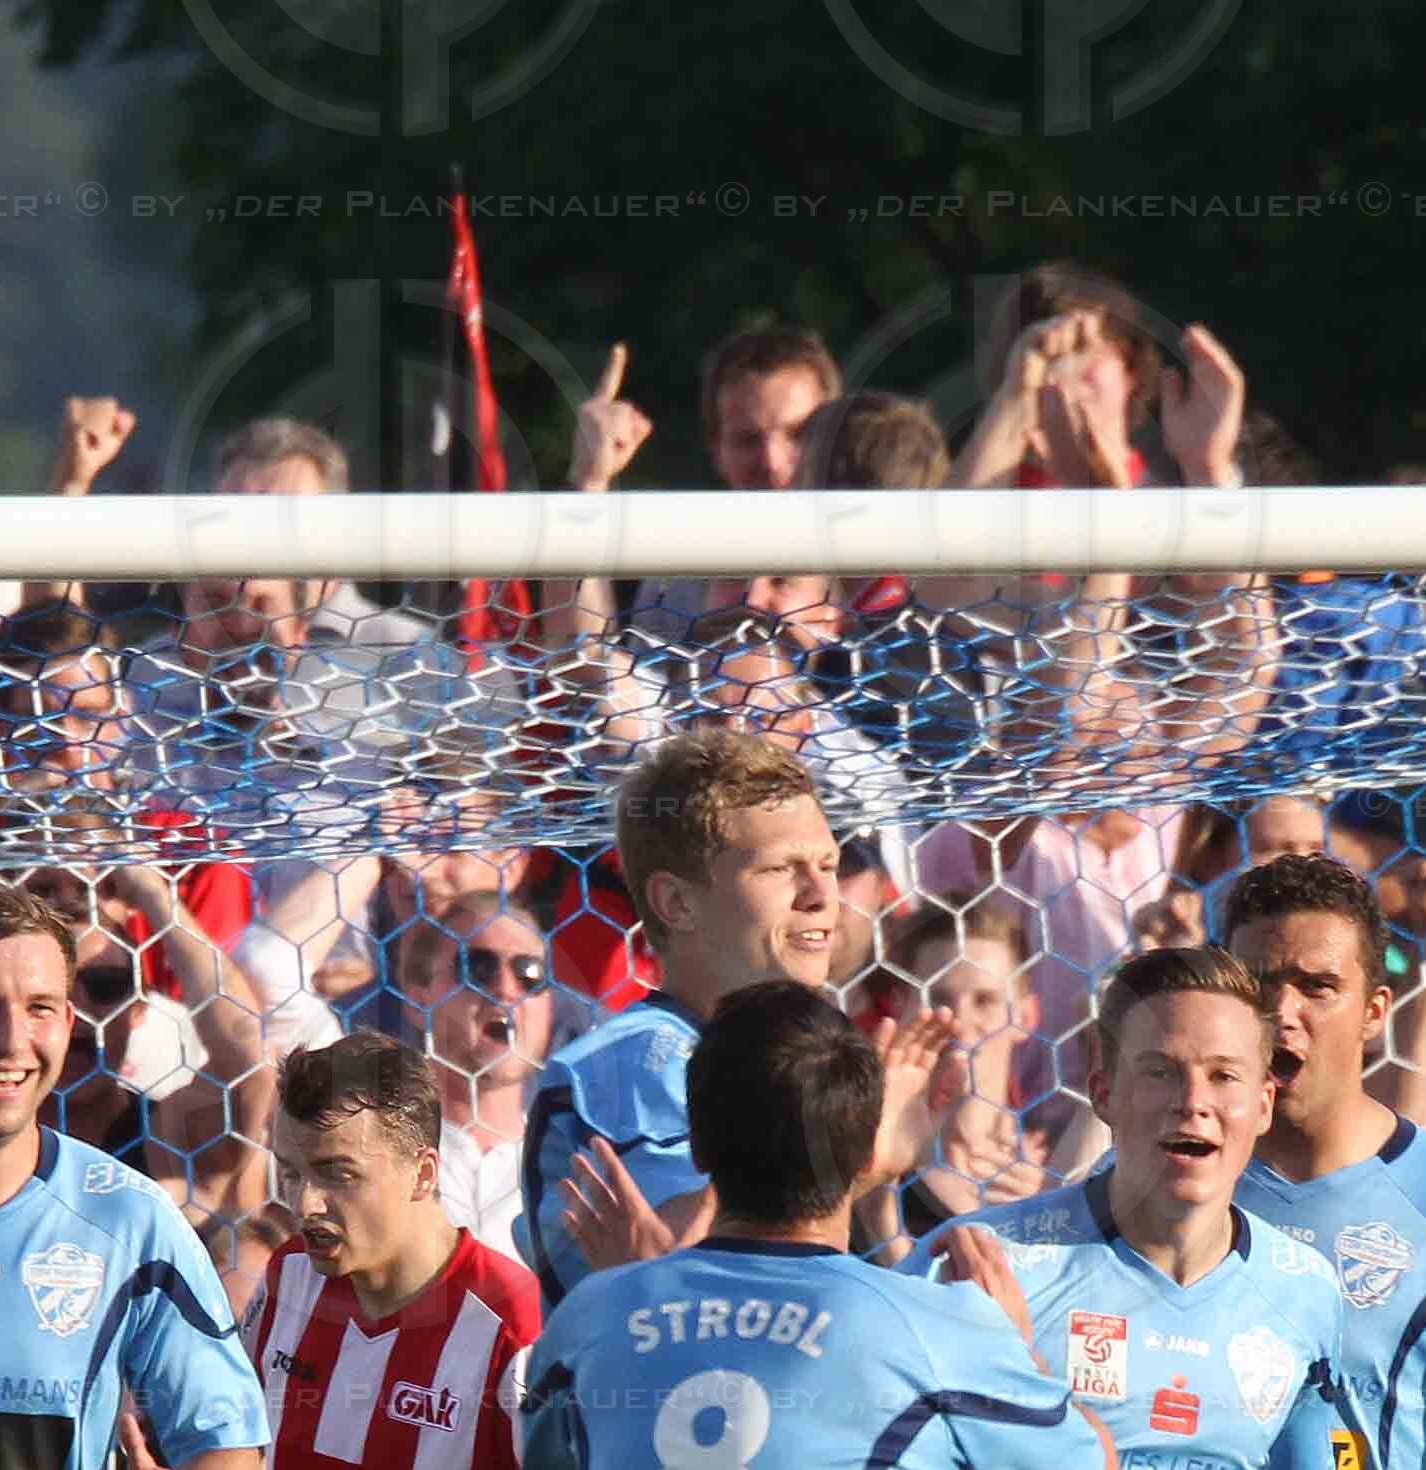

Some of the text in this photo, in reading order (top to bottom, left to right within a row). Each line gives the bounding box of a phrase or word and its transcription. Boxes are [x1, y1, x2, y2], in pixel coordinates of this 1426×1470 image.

[627, 1298, 833, 1360] STROBL
[393, 1386, 459, 1431] GAK
[1072, 1376, 1121, 1396] LIGA
